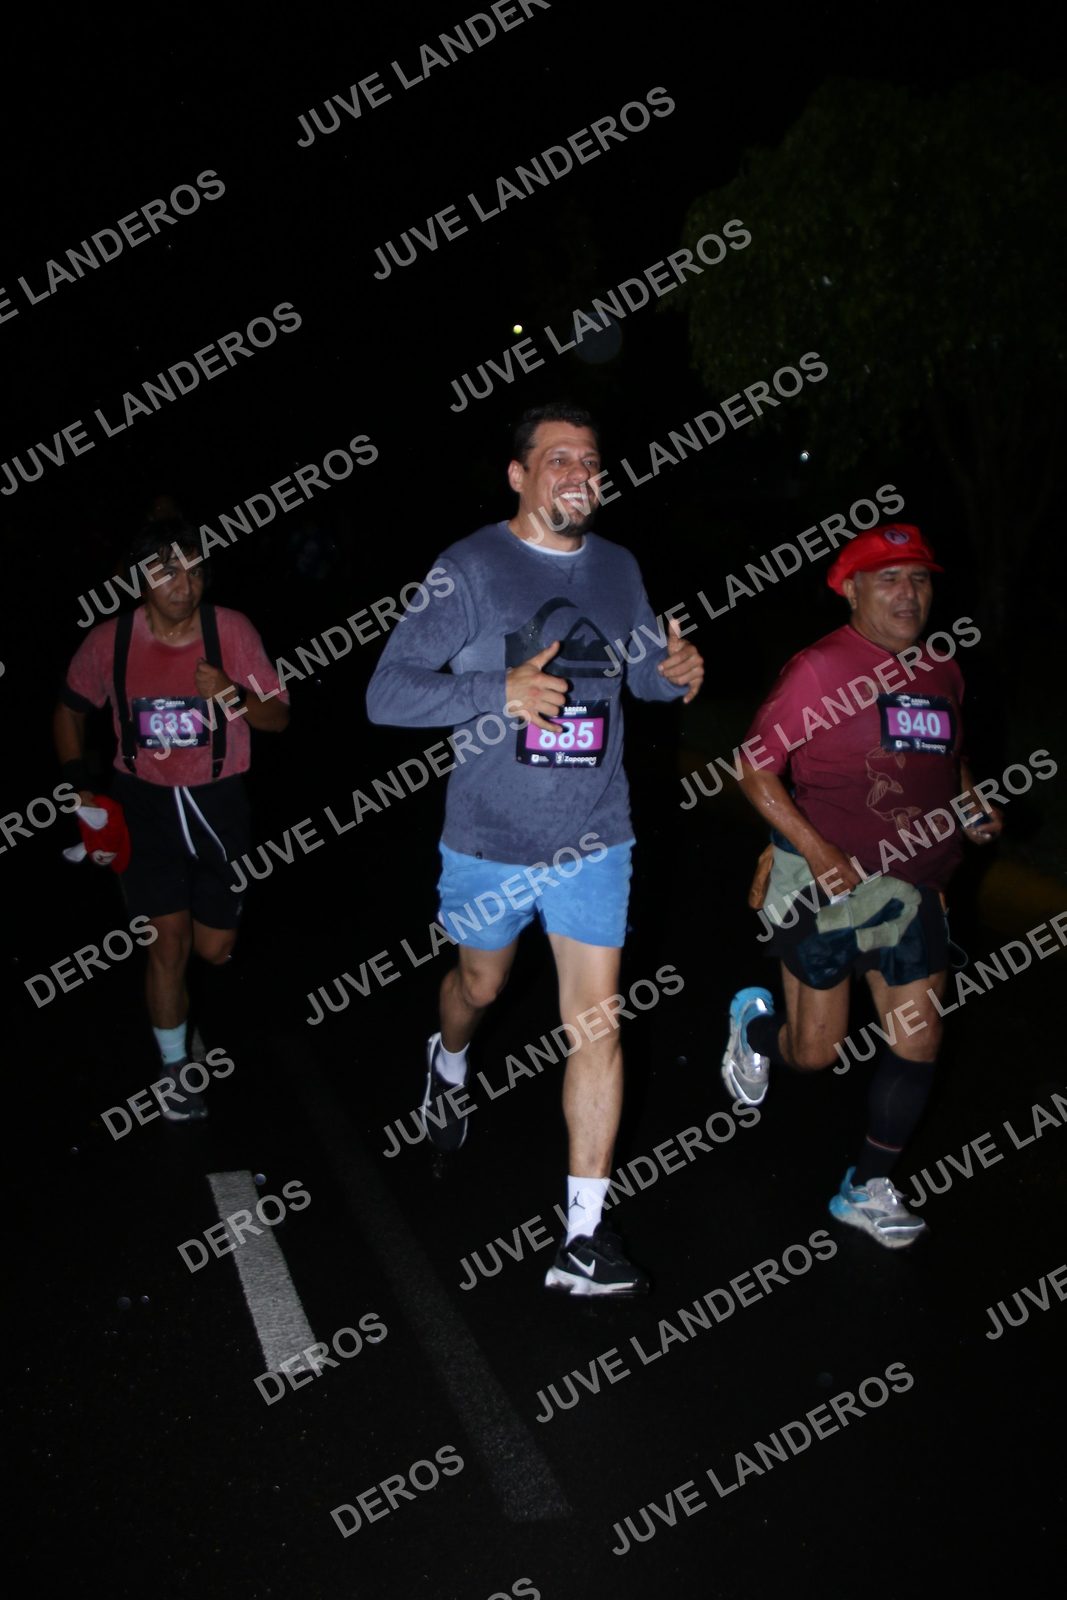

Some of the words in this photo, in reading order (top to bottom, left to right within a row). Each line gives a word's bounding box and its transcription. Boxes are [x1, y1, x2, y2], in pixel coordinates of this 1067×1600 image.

[150, 712, 193, 733] 635
[539, 721, 594, 748] 885
[897, 710, 941, 736] 940
